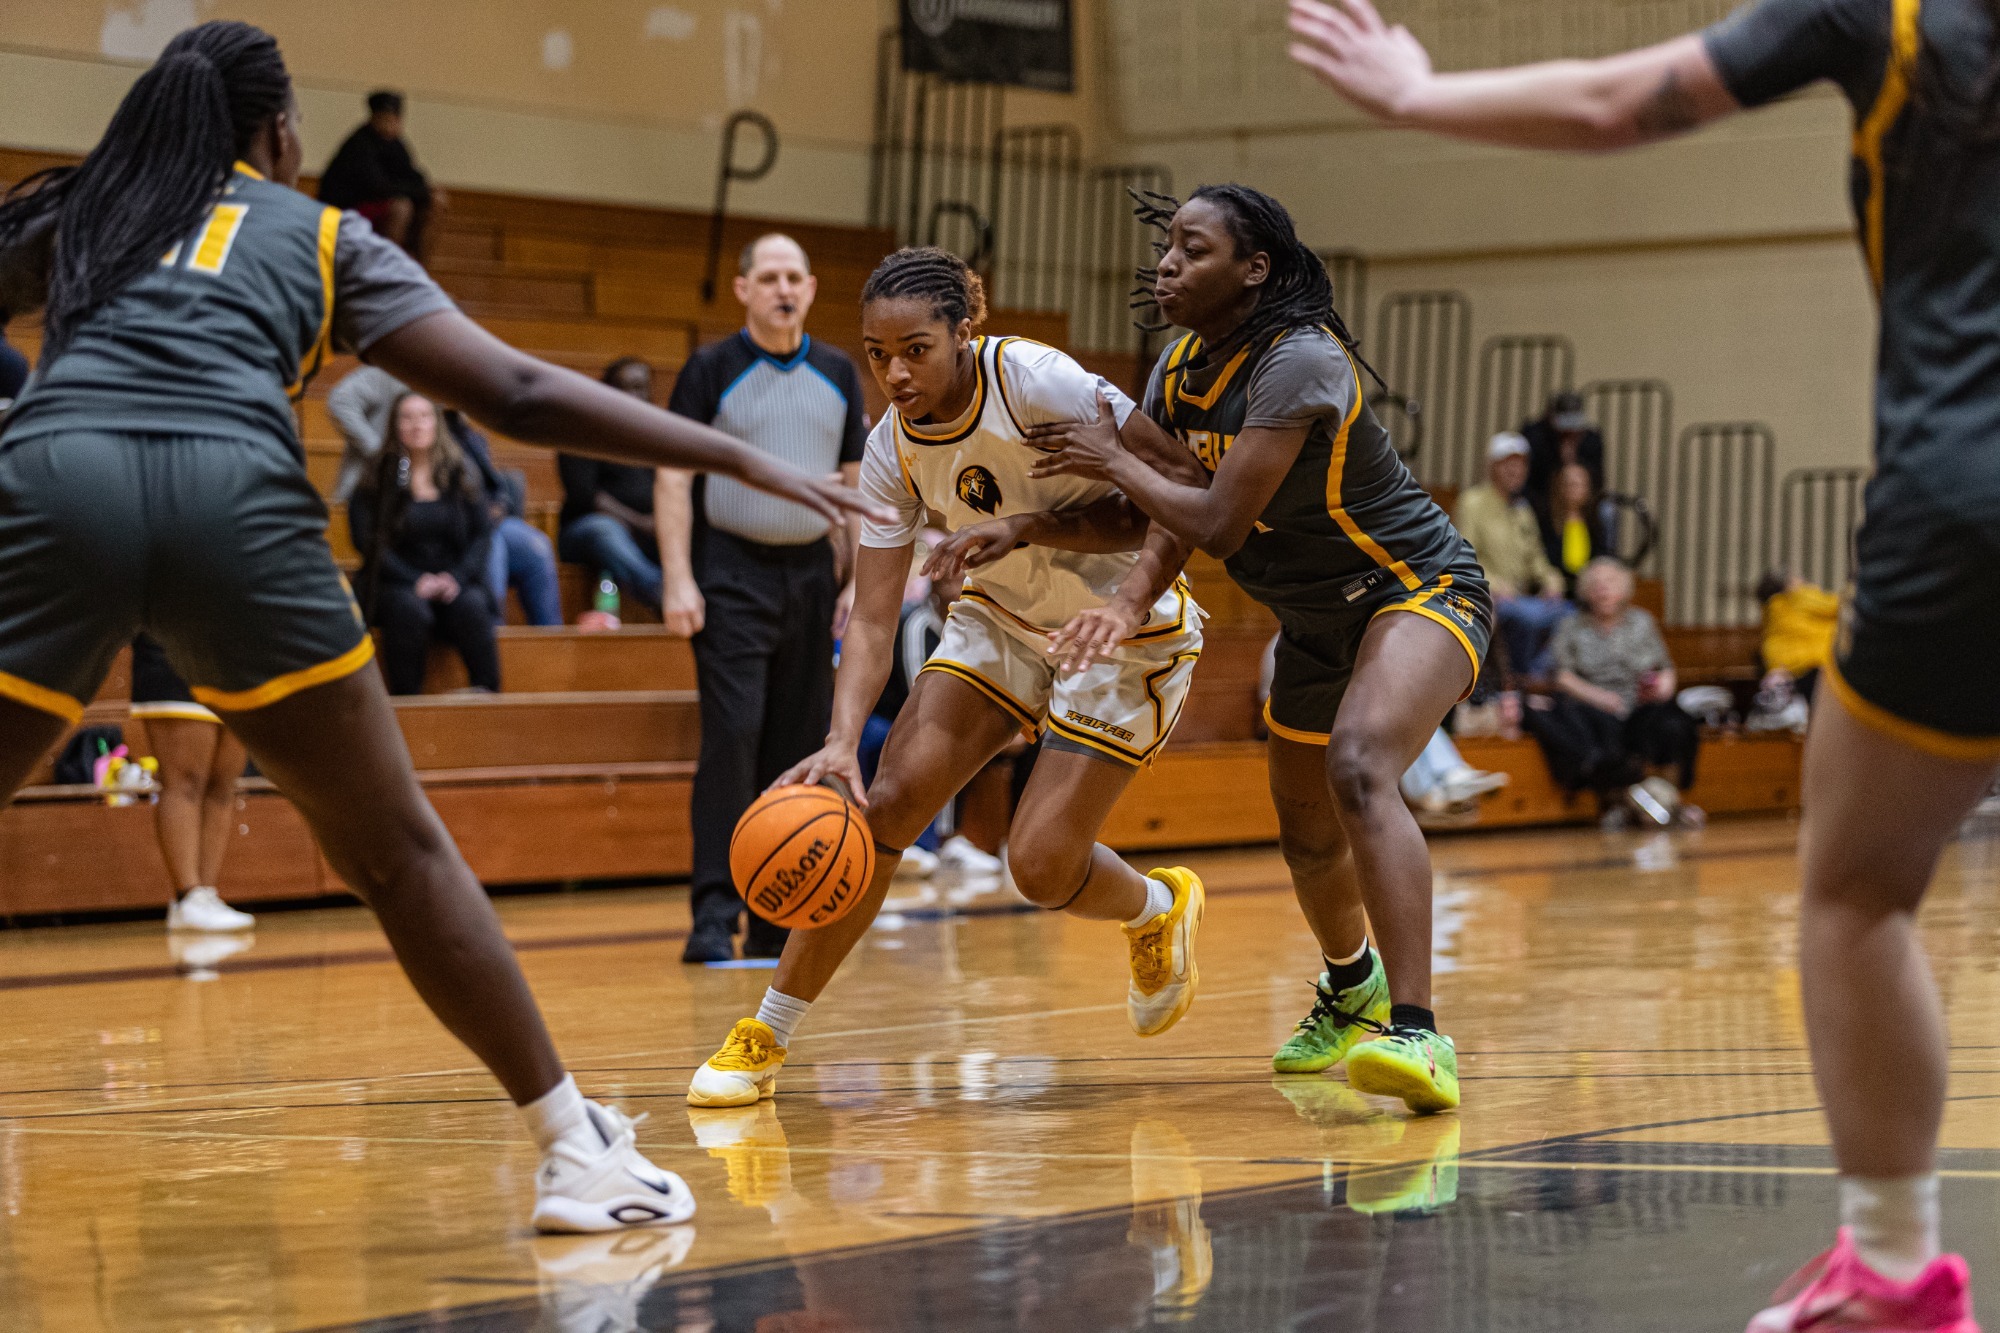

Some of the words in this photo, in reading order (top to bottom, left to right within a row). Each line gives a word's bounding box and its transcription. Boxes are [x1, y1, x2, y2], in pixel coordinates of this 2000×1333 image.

[1367, 577, 1377, 587] M
[1065, 710, 1135, 742] PFEIFFER
[754, 840, 832, 912] Wilson
